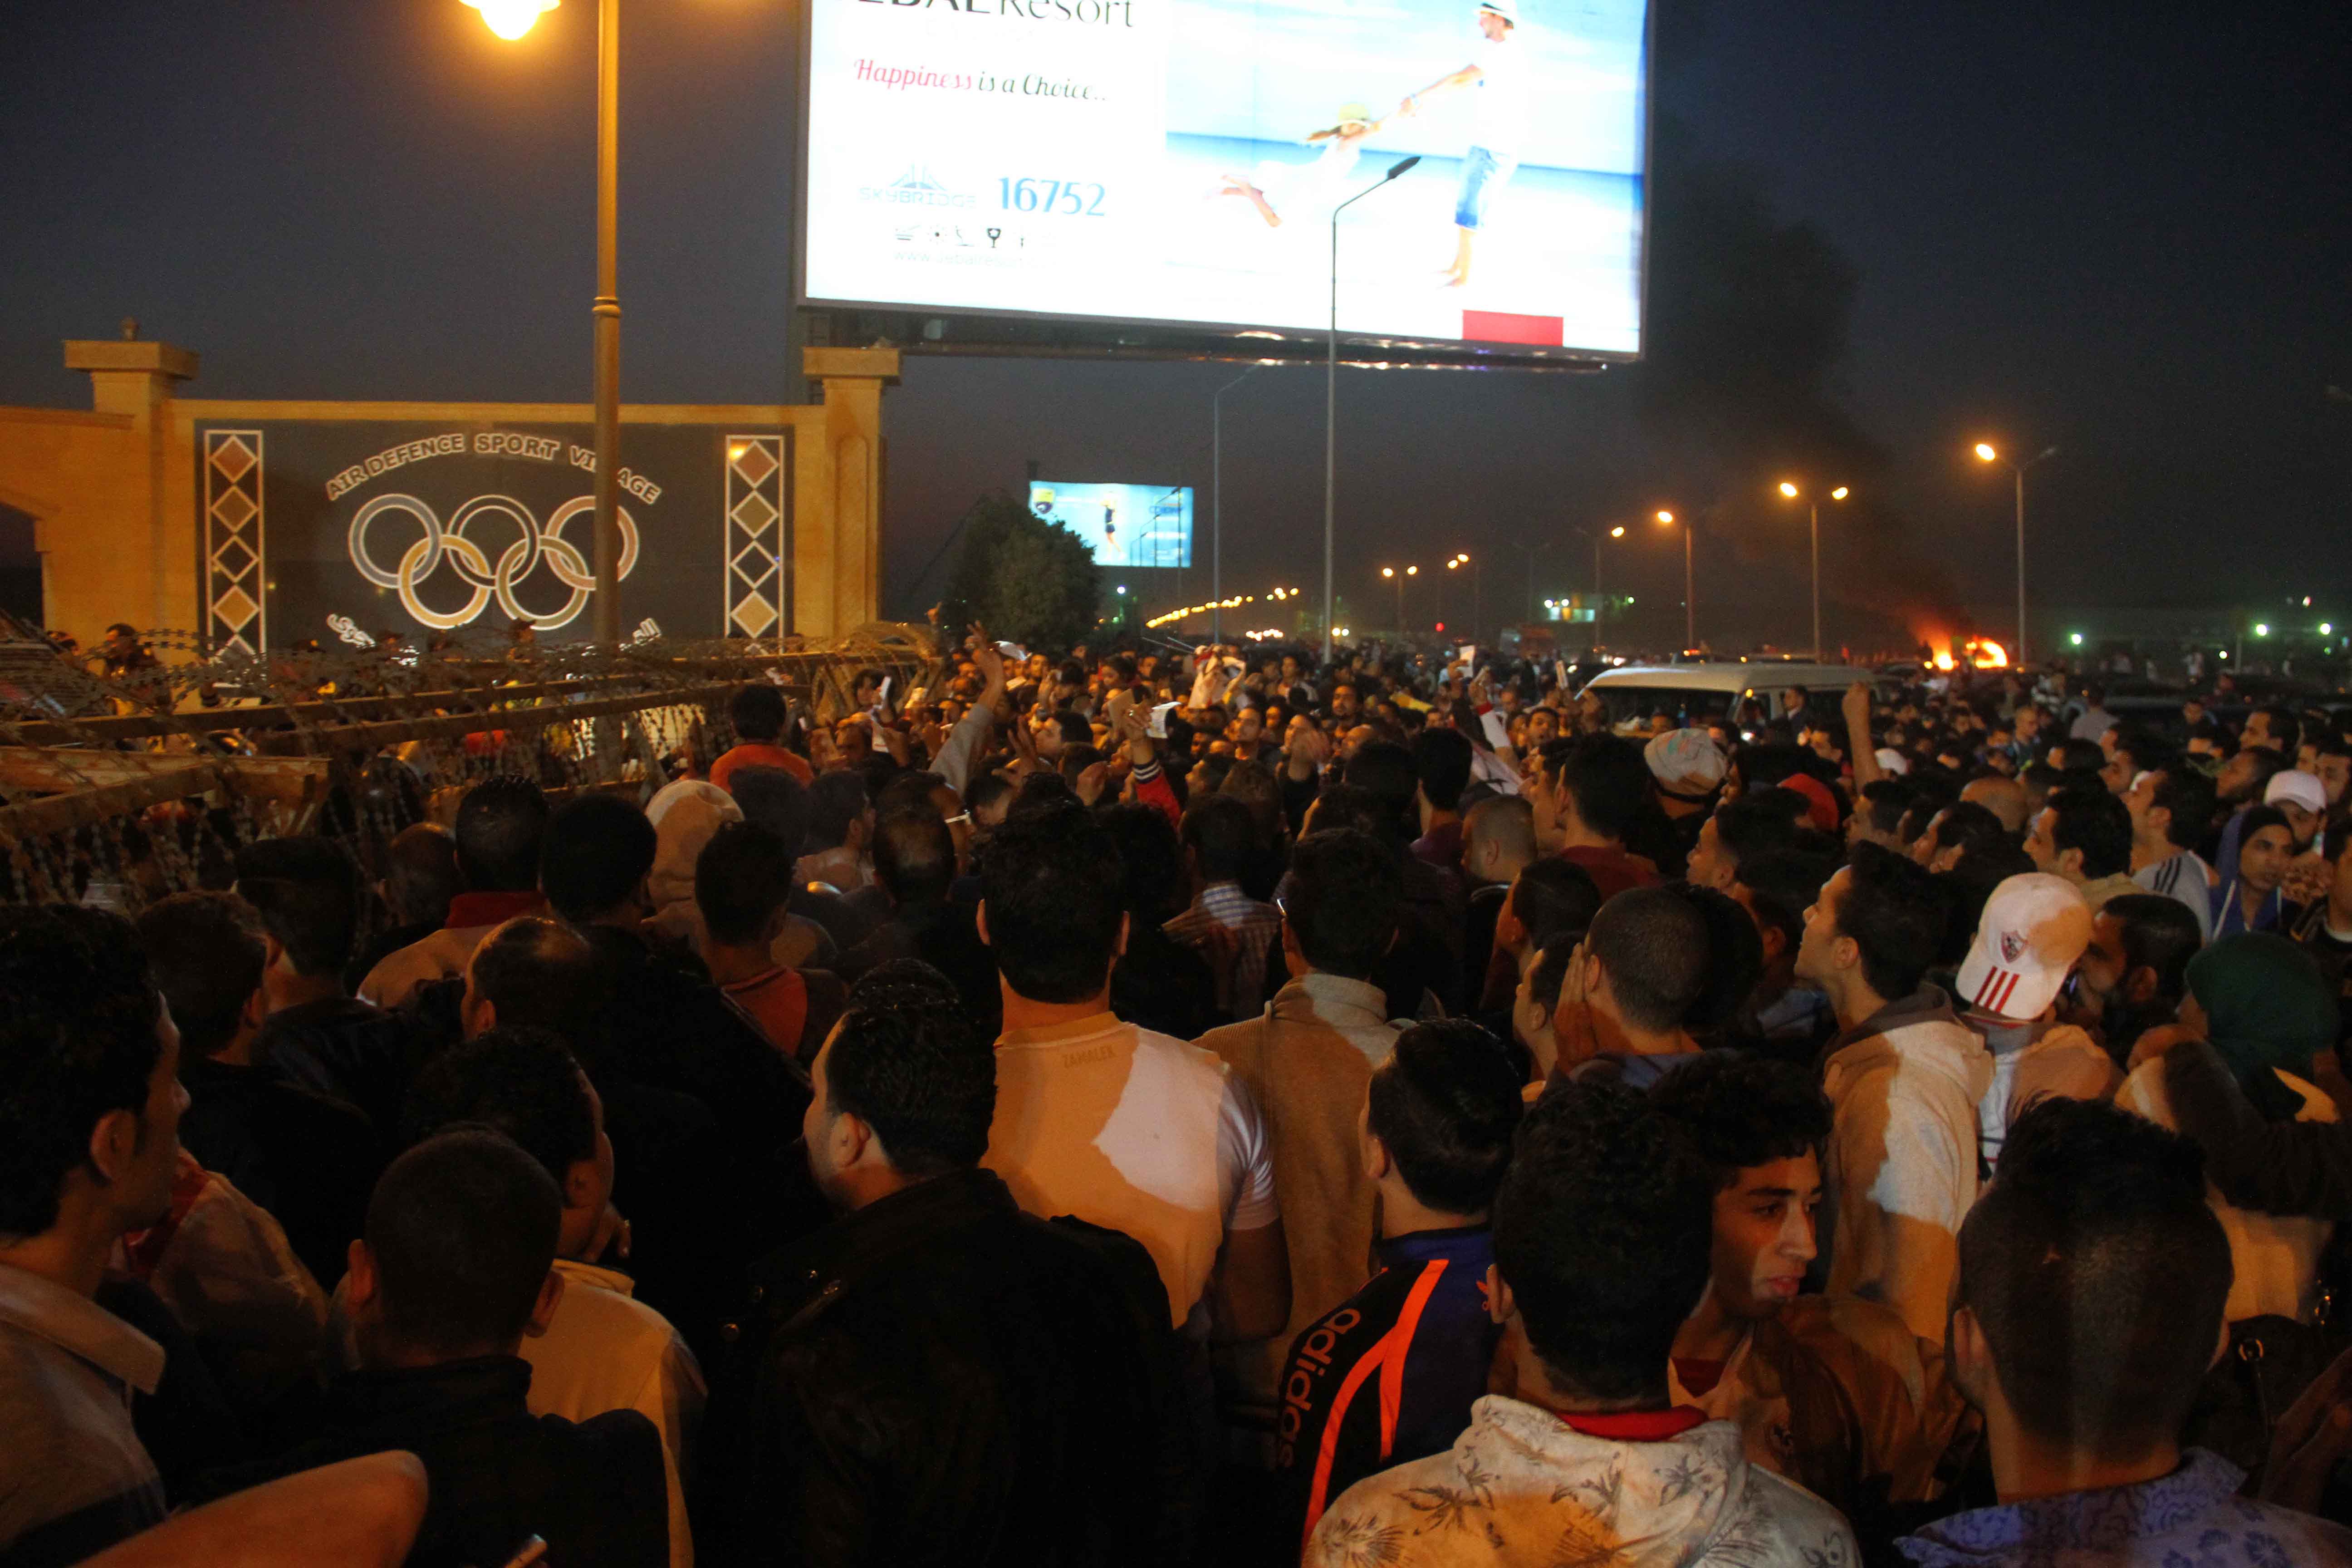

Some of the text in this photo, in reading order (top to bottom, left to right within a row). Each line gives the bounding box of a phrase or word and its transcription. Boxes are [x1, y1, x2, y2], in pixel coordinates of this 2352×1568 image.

[854, 59, 972, 91] Happiness
[978, 71, 996, 92] is
[1001, 80, 1015, 94] a
[998, 177, 1106, 217] 16752
[326, 433, 662, 505] AIR DEFENCE SPORT VIAGE
